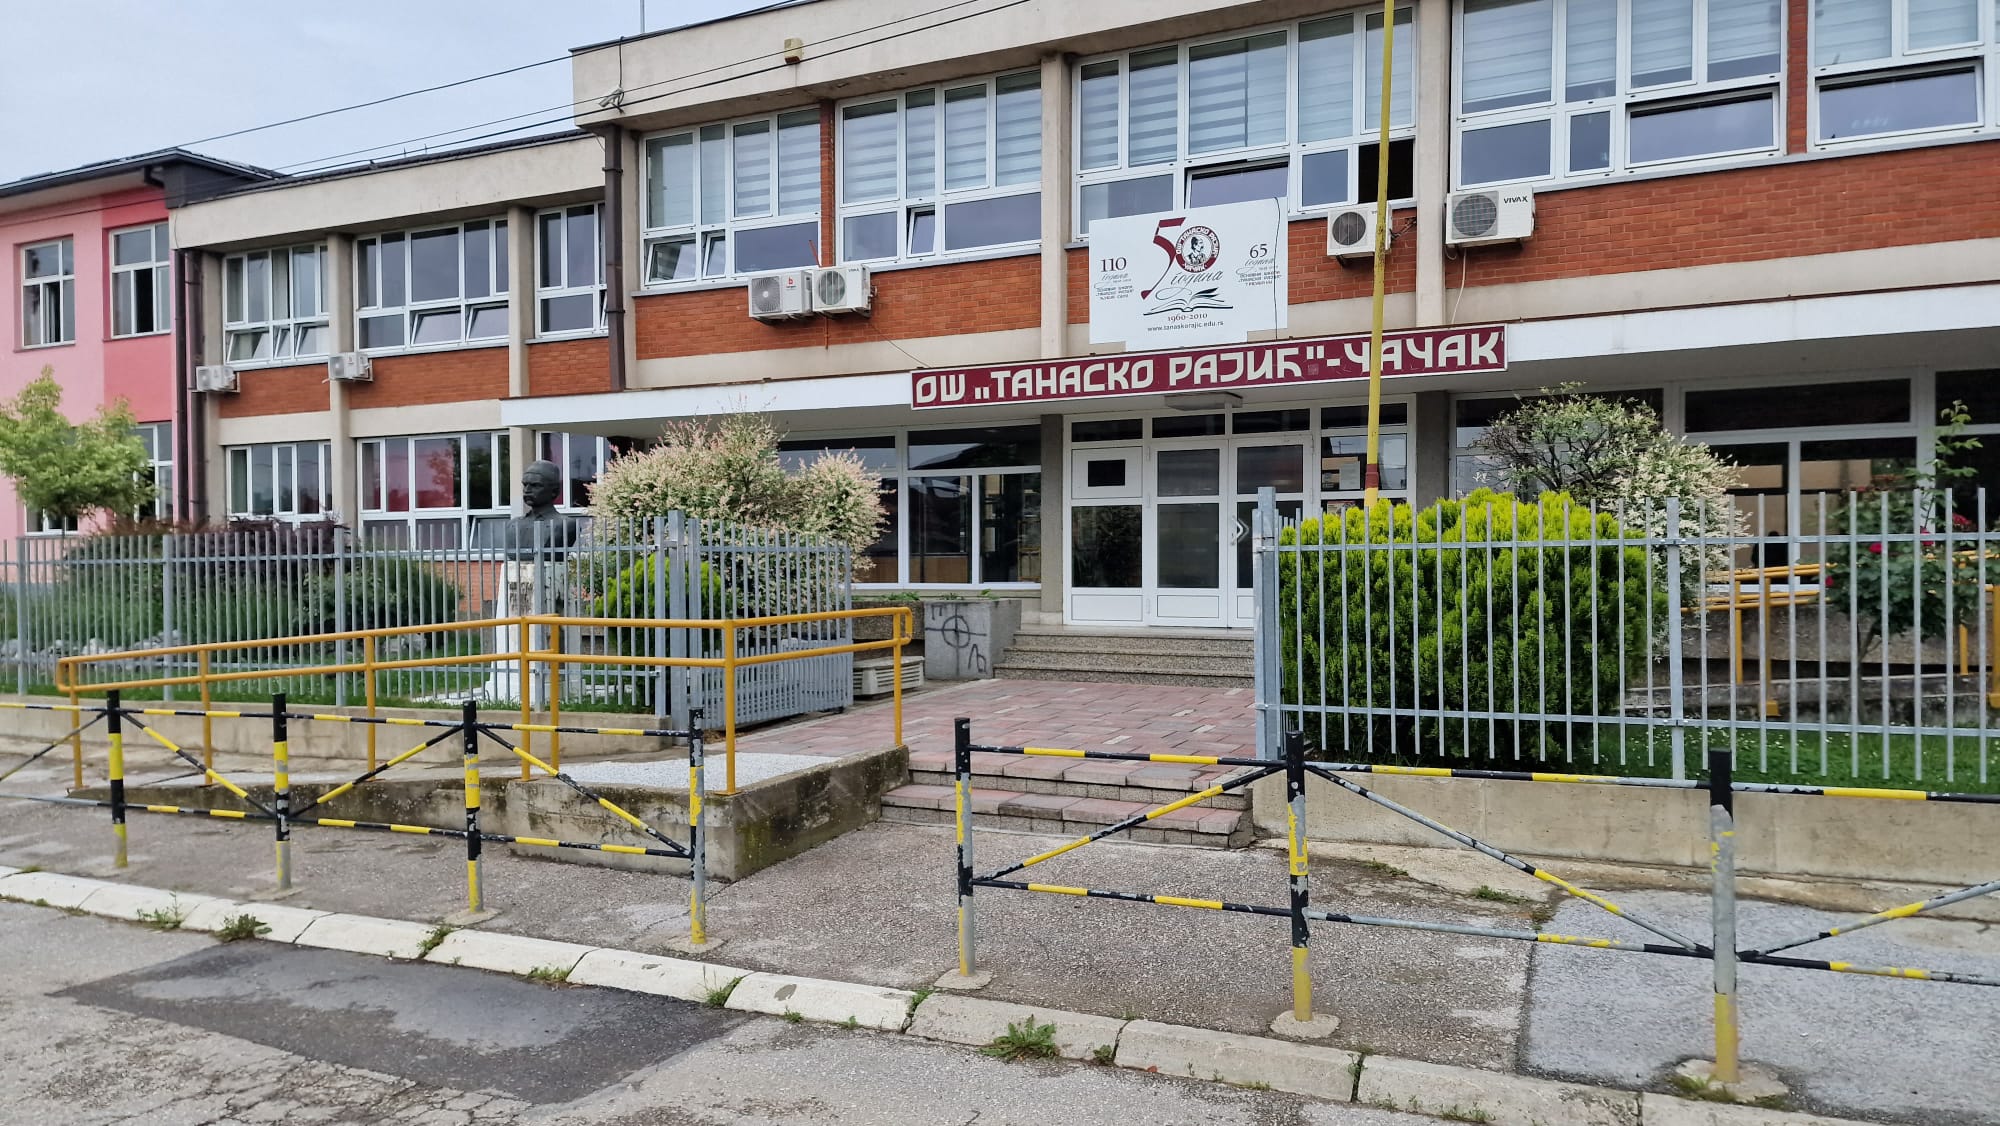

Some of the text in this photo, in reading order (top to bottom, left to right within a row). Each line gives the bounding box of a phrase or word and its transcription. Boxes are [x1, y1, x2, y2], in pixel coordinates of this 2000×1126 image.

[1503, 195, 1528, 204] VIVAX
[1249, 243, 1268, 259] 65
[1100, 256, 1127, 273] 110
[1167, 313, 1208, 322] 1960-2010
[1147, 320, 1224, 332] www.tanaskorajic.edu.rs
[916, 374, 966, 404] ОШ
